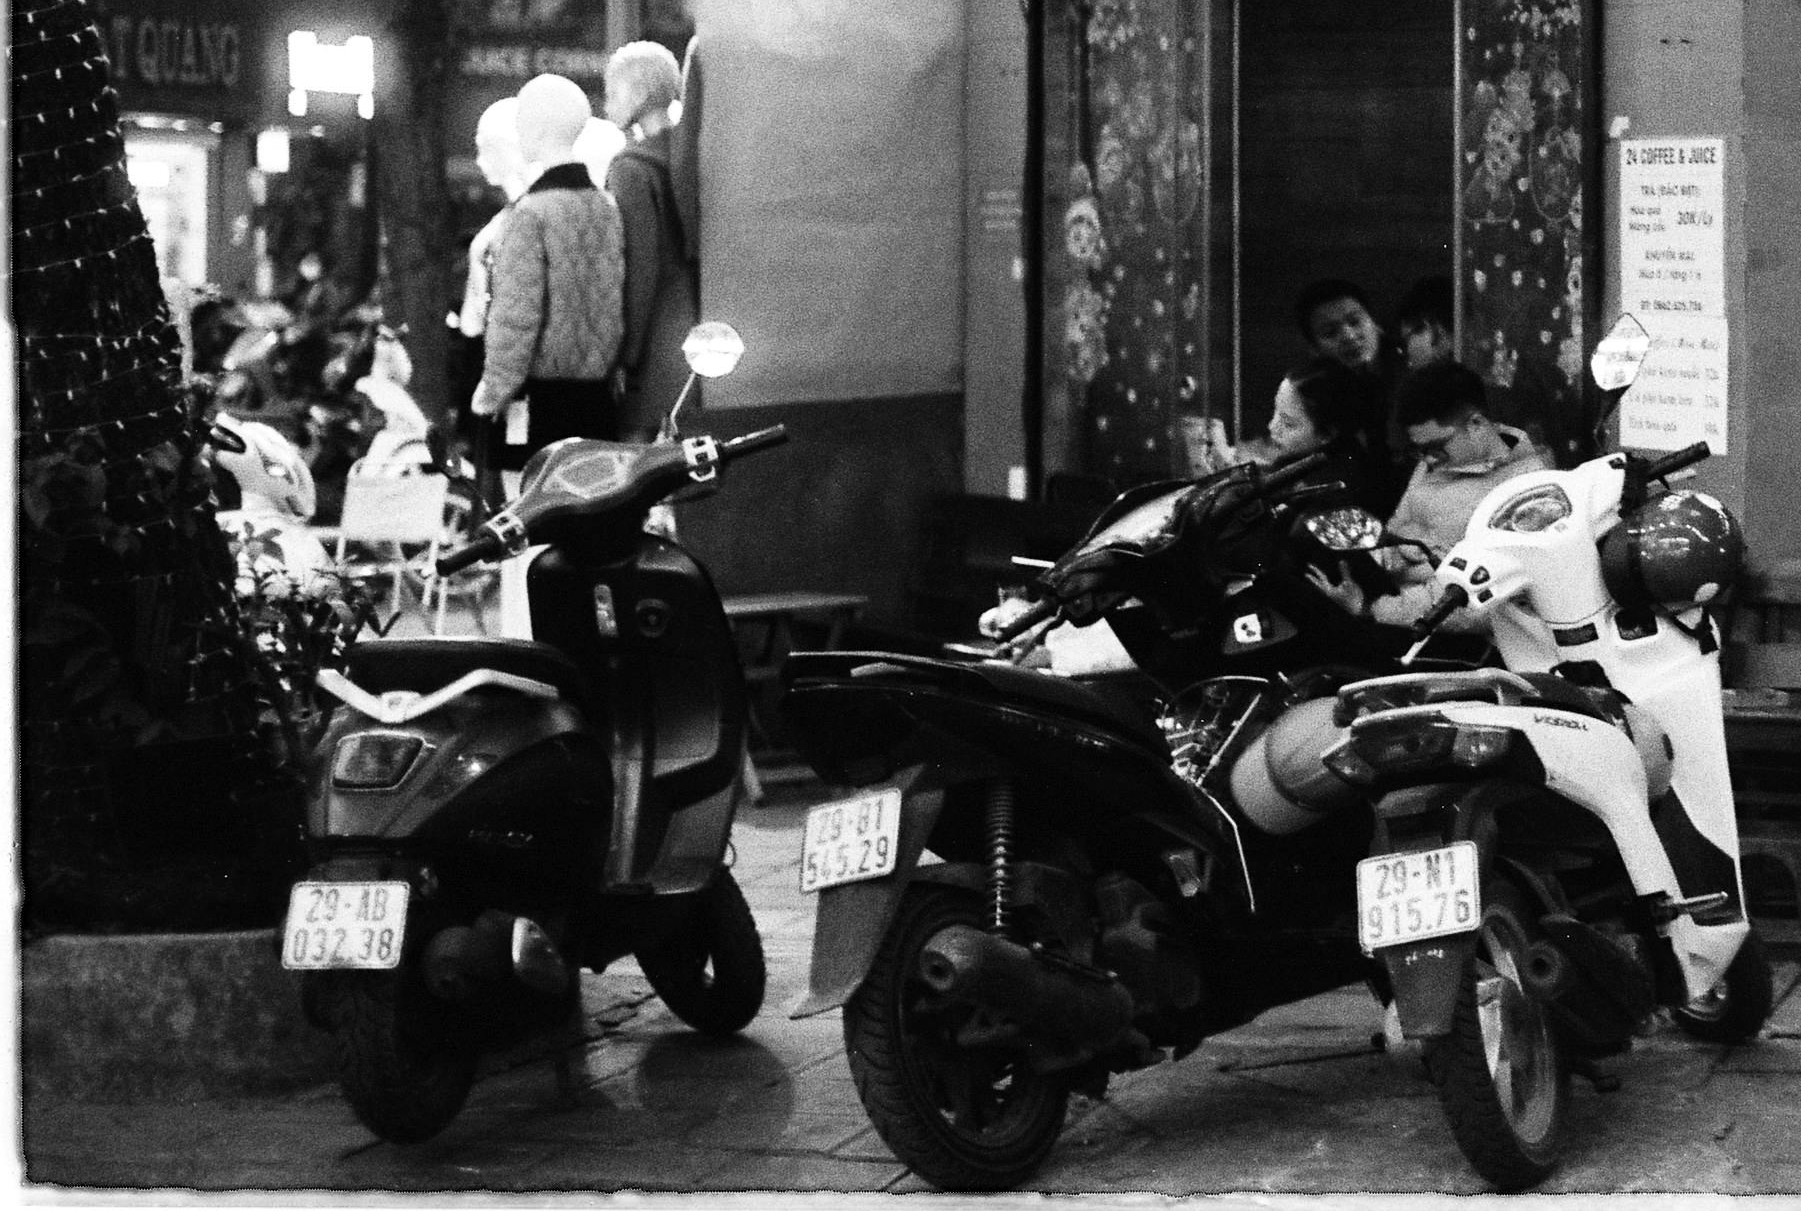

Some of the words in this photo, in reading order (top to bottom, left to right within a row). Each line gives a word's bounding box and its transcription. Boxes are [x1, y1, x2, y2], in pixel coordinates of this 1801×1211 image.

[1626, 148, 1638, 165] 24
[1641, 147, 1675, 164] COFFEE
[1678, 148, 1686, 164] &
[1688, 146, 1717, 164] JUICE
[1368, 889, 1470, 939] 915.76
